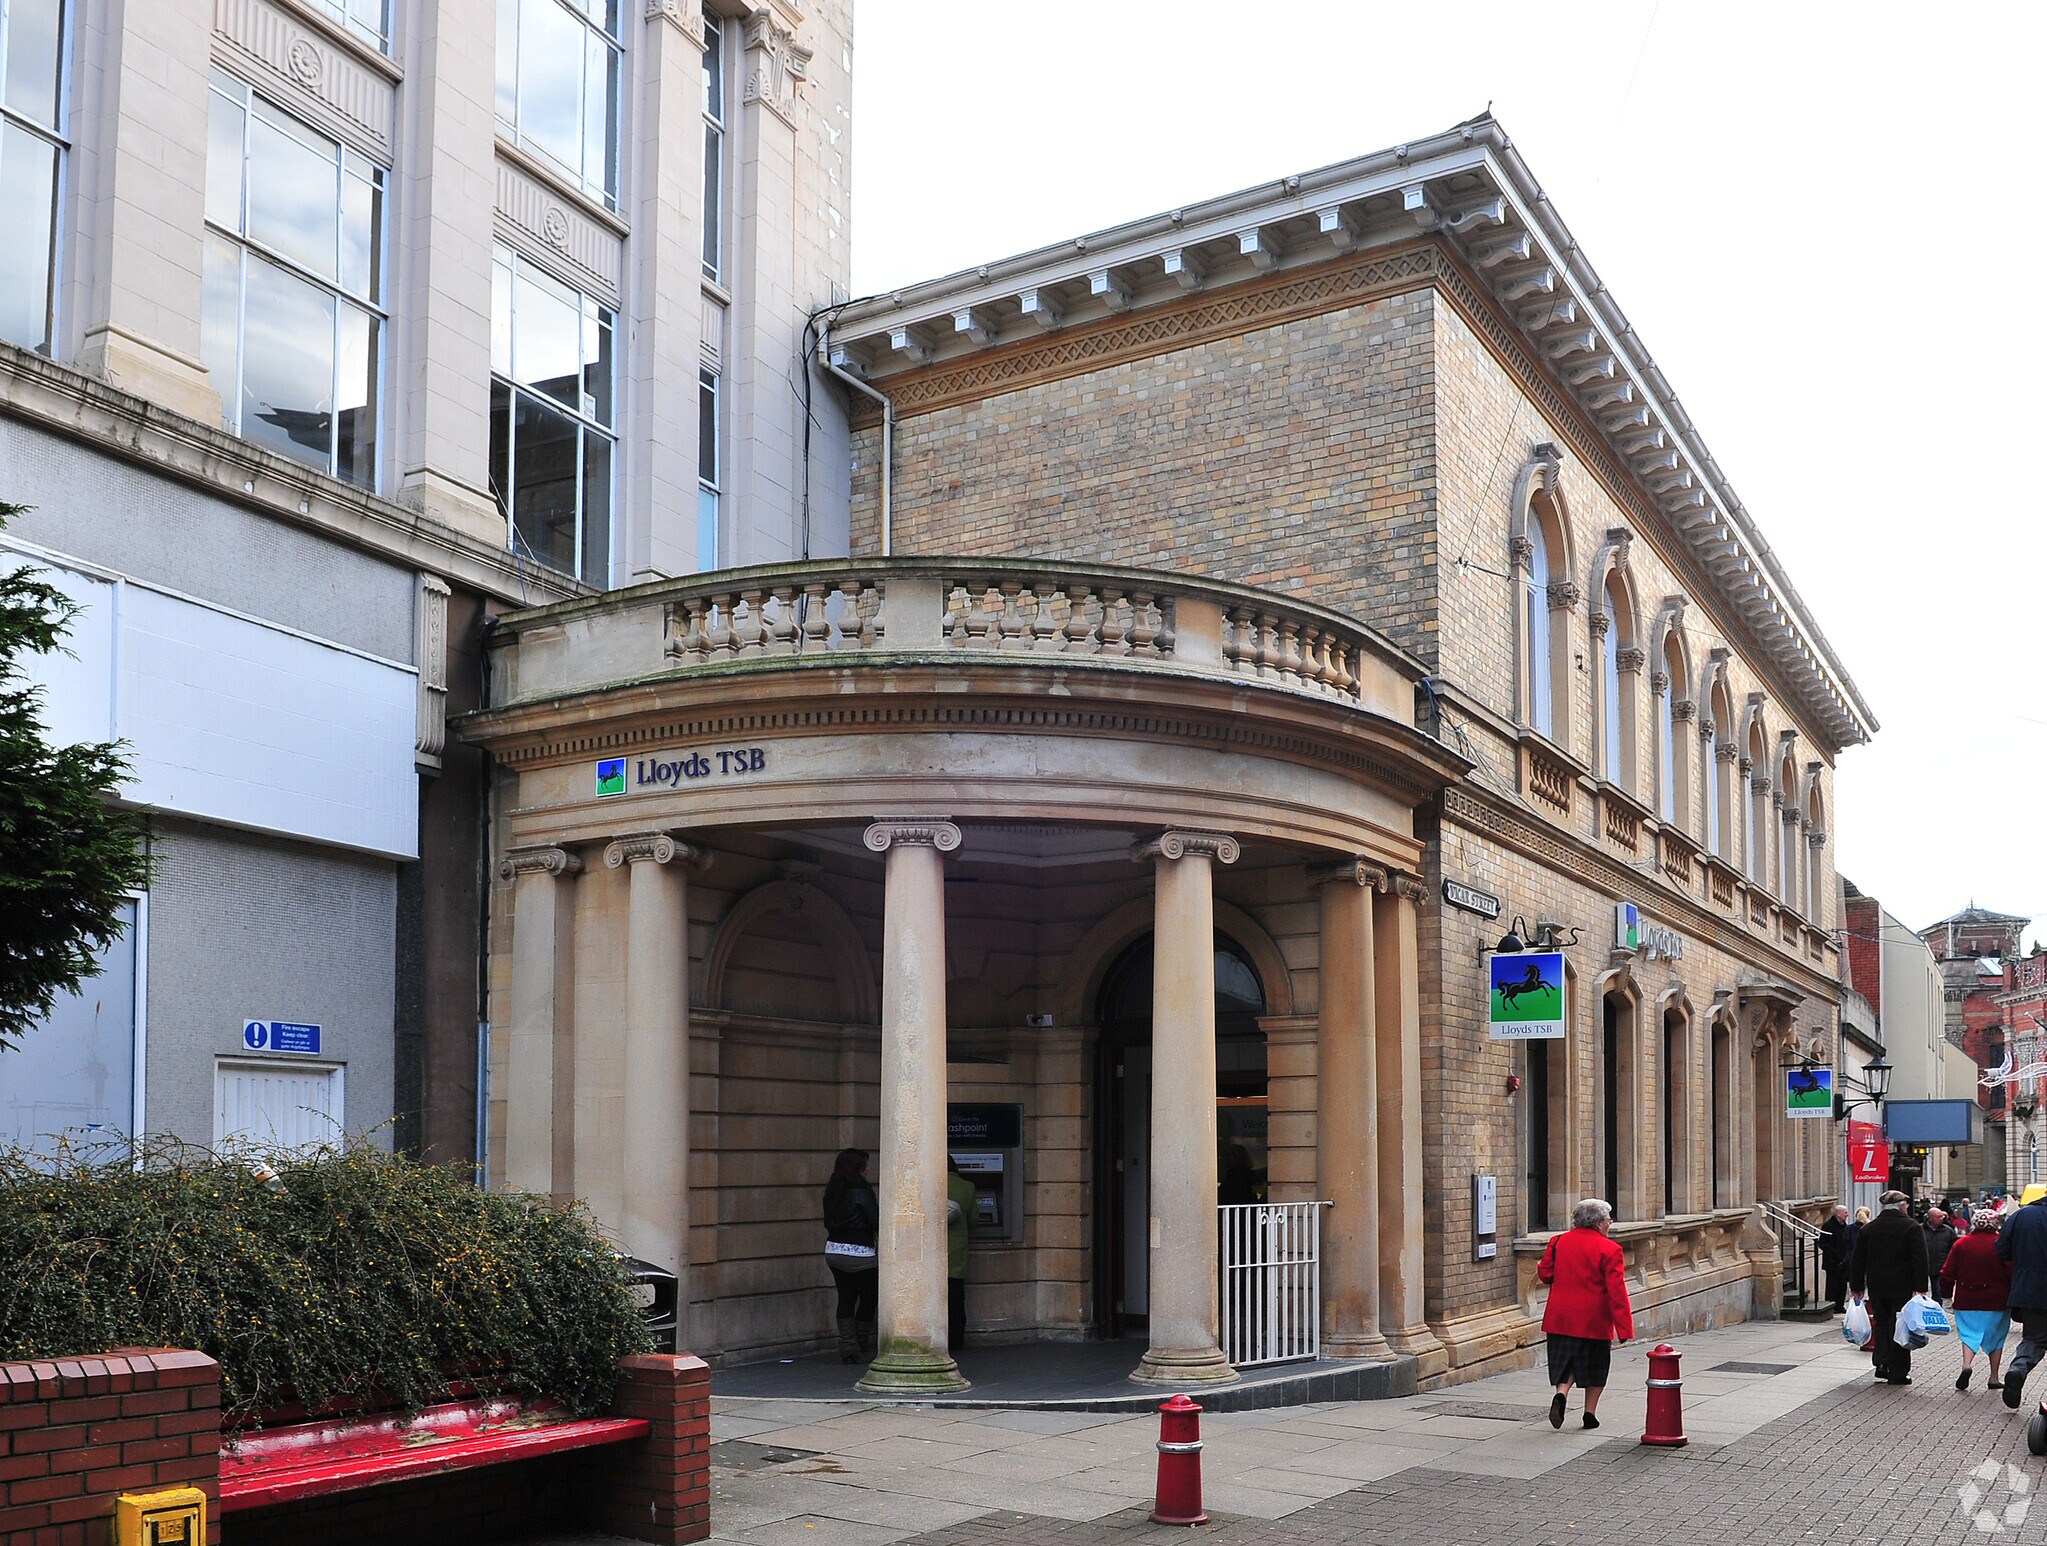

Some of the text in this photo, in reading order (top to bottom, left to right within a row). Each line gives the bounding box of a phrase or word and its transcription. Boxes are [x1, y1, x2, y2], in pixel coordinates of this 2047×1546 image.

[636, 748, 766, 787] Lloyds TSB
[1449, 885, 1494, 912] VICAR STREET
[1638, 917, 1667, 961] Lloyds
[1501, 1025, 1552, 1036] Lloyds TSB
[948, 1124, 987, 1133] ashpoint
[1862, 1150, 1877, 1172] L
